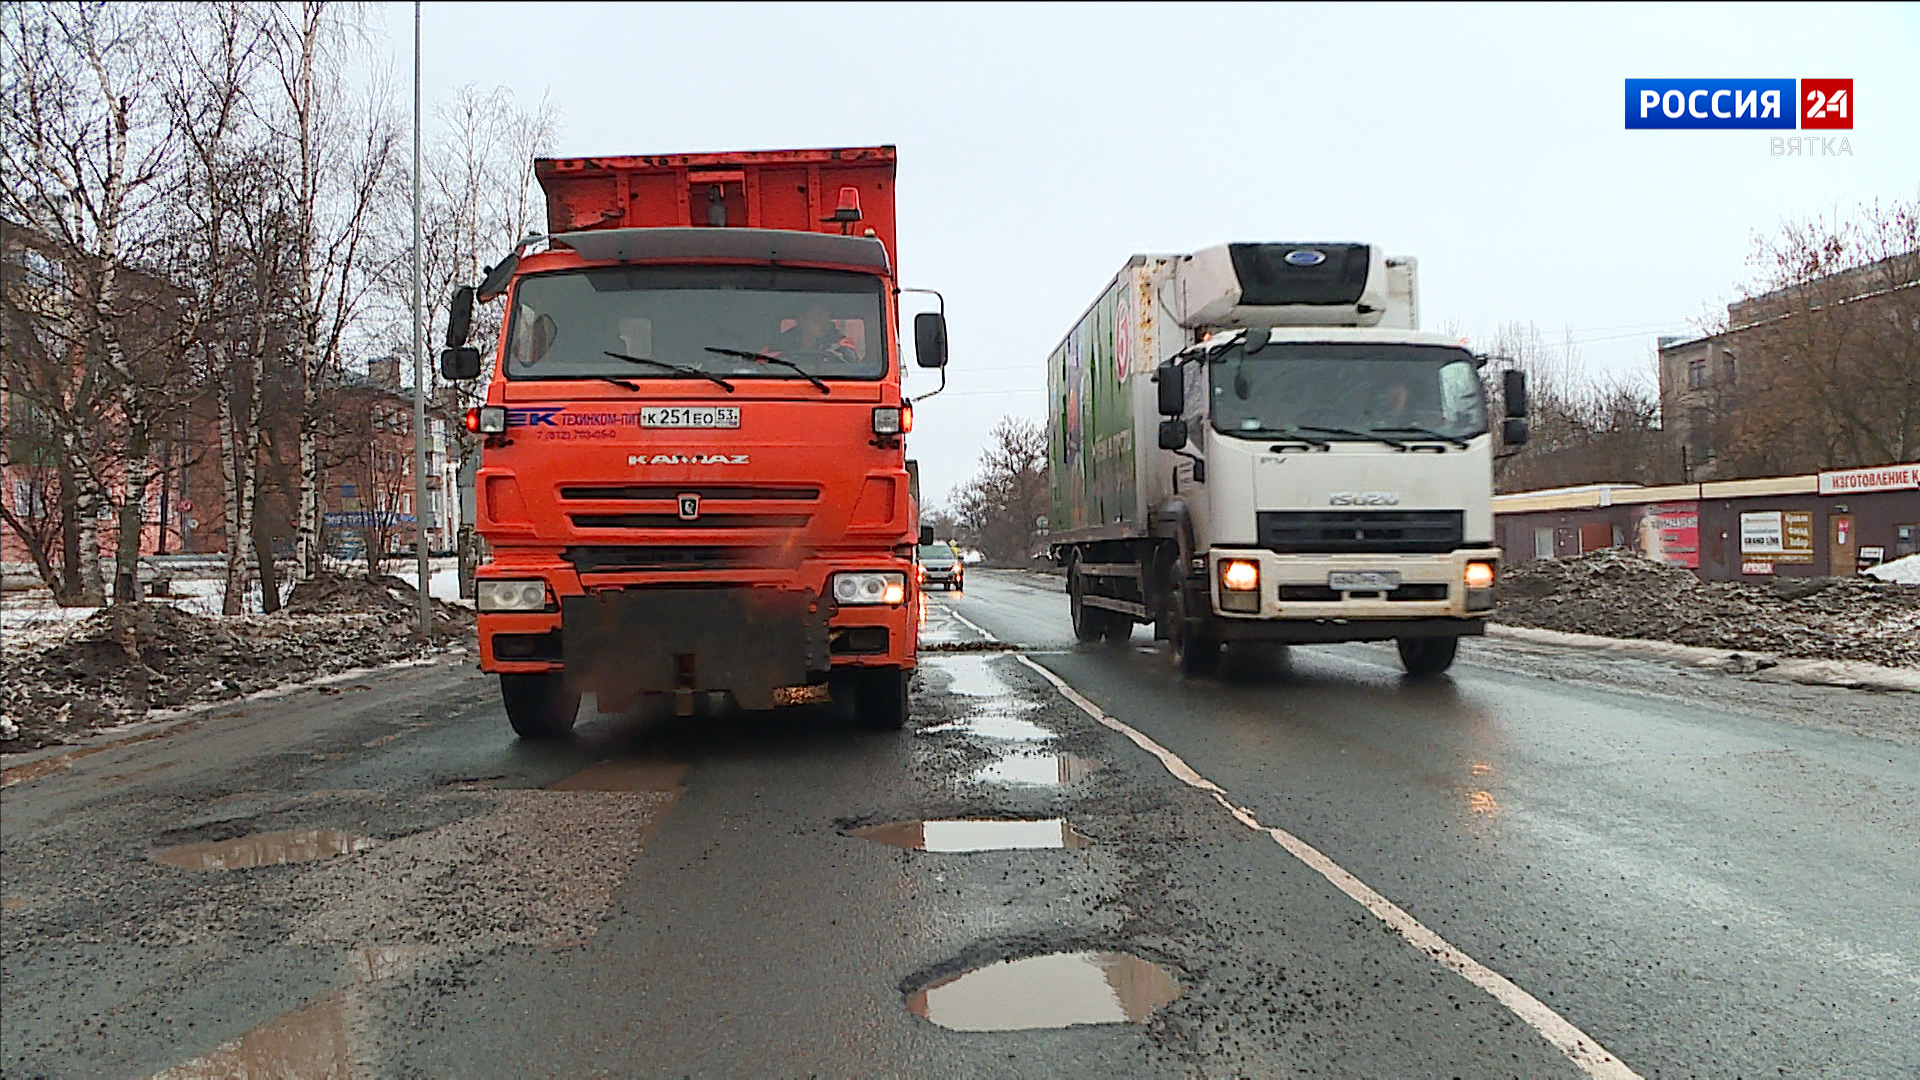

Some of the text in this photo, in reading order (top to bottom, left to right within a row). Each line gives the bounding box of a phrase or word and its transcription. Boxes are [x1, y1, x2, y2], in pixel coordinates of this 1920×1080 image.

[628, 455, 750, 466] KAMAZ
[1832, 471, 1908, 488] ИЗГОТОВЛЕНИЕ
[1329, 492, 1400, 506] ISUZU
